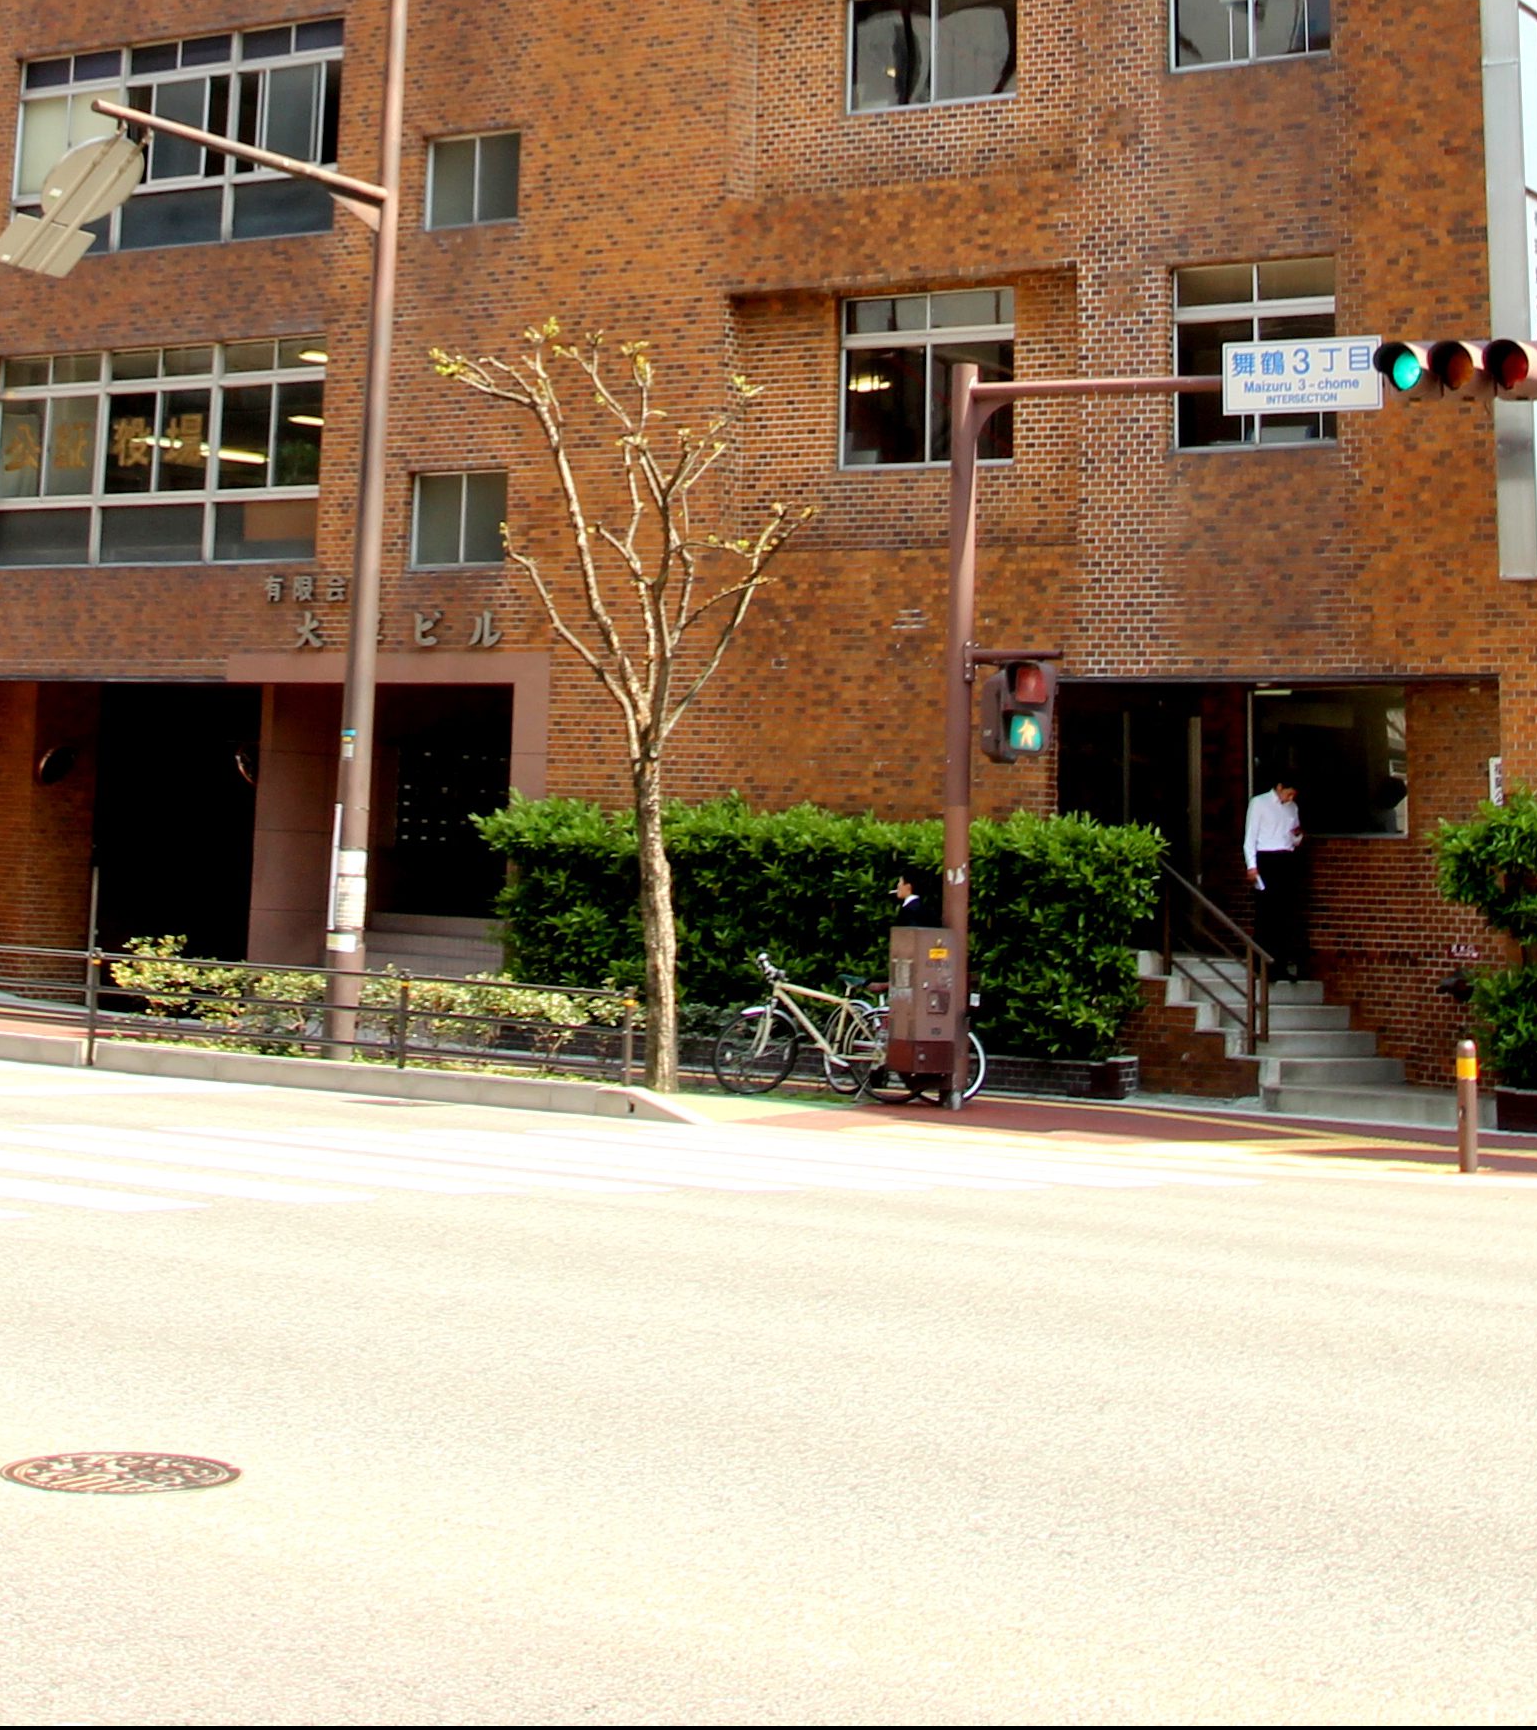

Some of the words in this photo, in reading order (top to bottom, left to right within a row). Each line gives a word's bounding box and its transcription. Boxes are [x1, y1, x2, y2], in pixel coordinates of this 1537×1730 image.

[1231, 345, 1372, 377] 舞鶴3丁目
[1244, 380, 1292, 393] Maizuru
[1266, 393, 1337, 404] INTERSECTION
[295, 609, 503, 648] 大ビル
